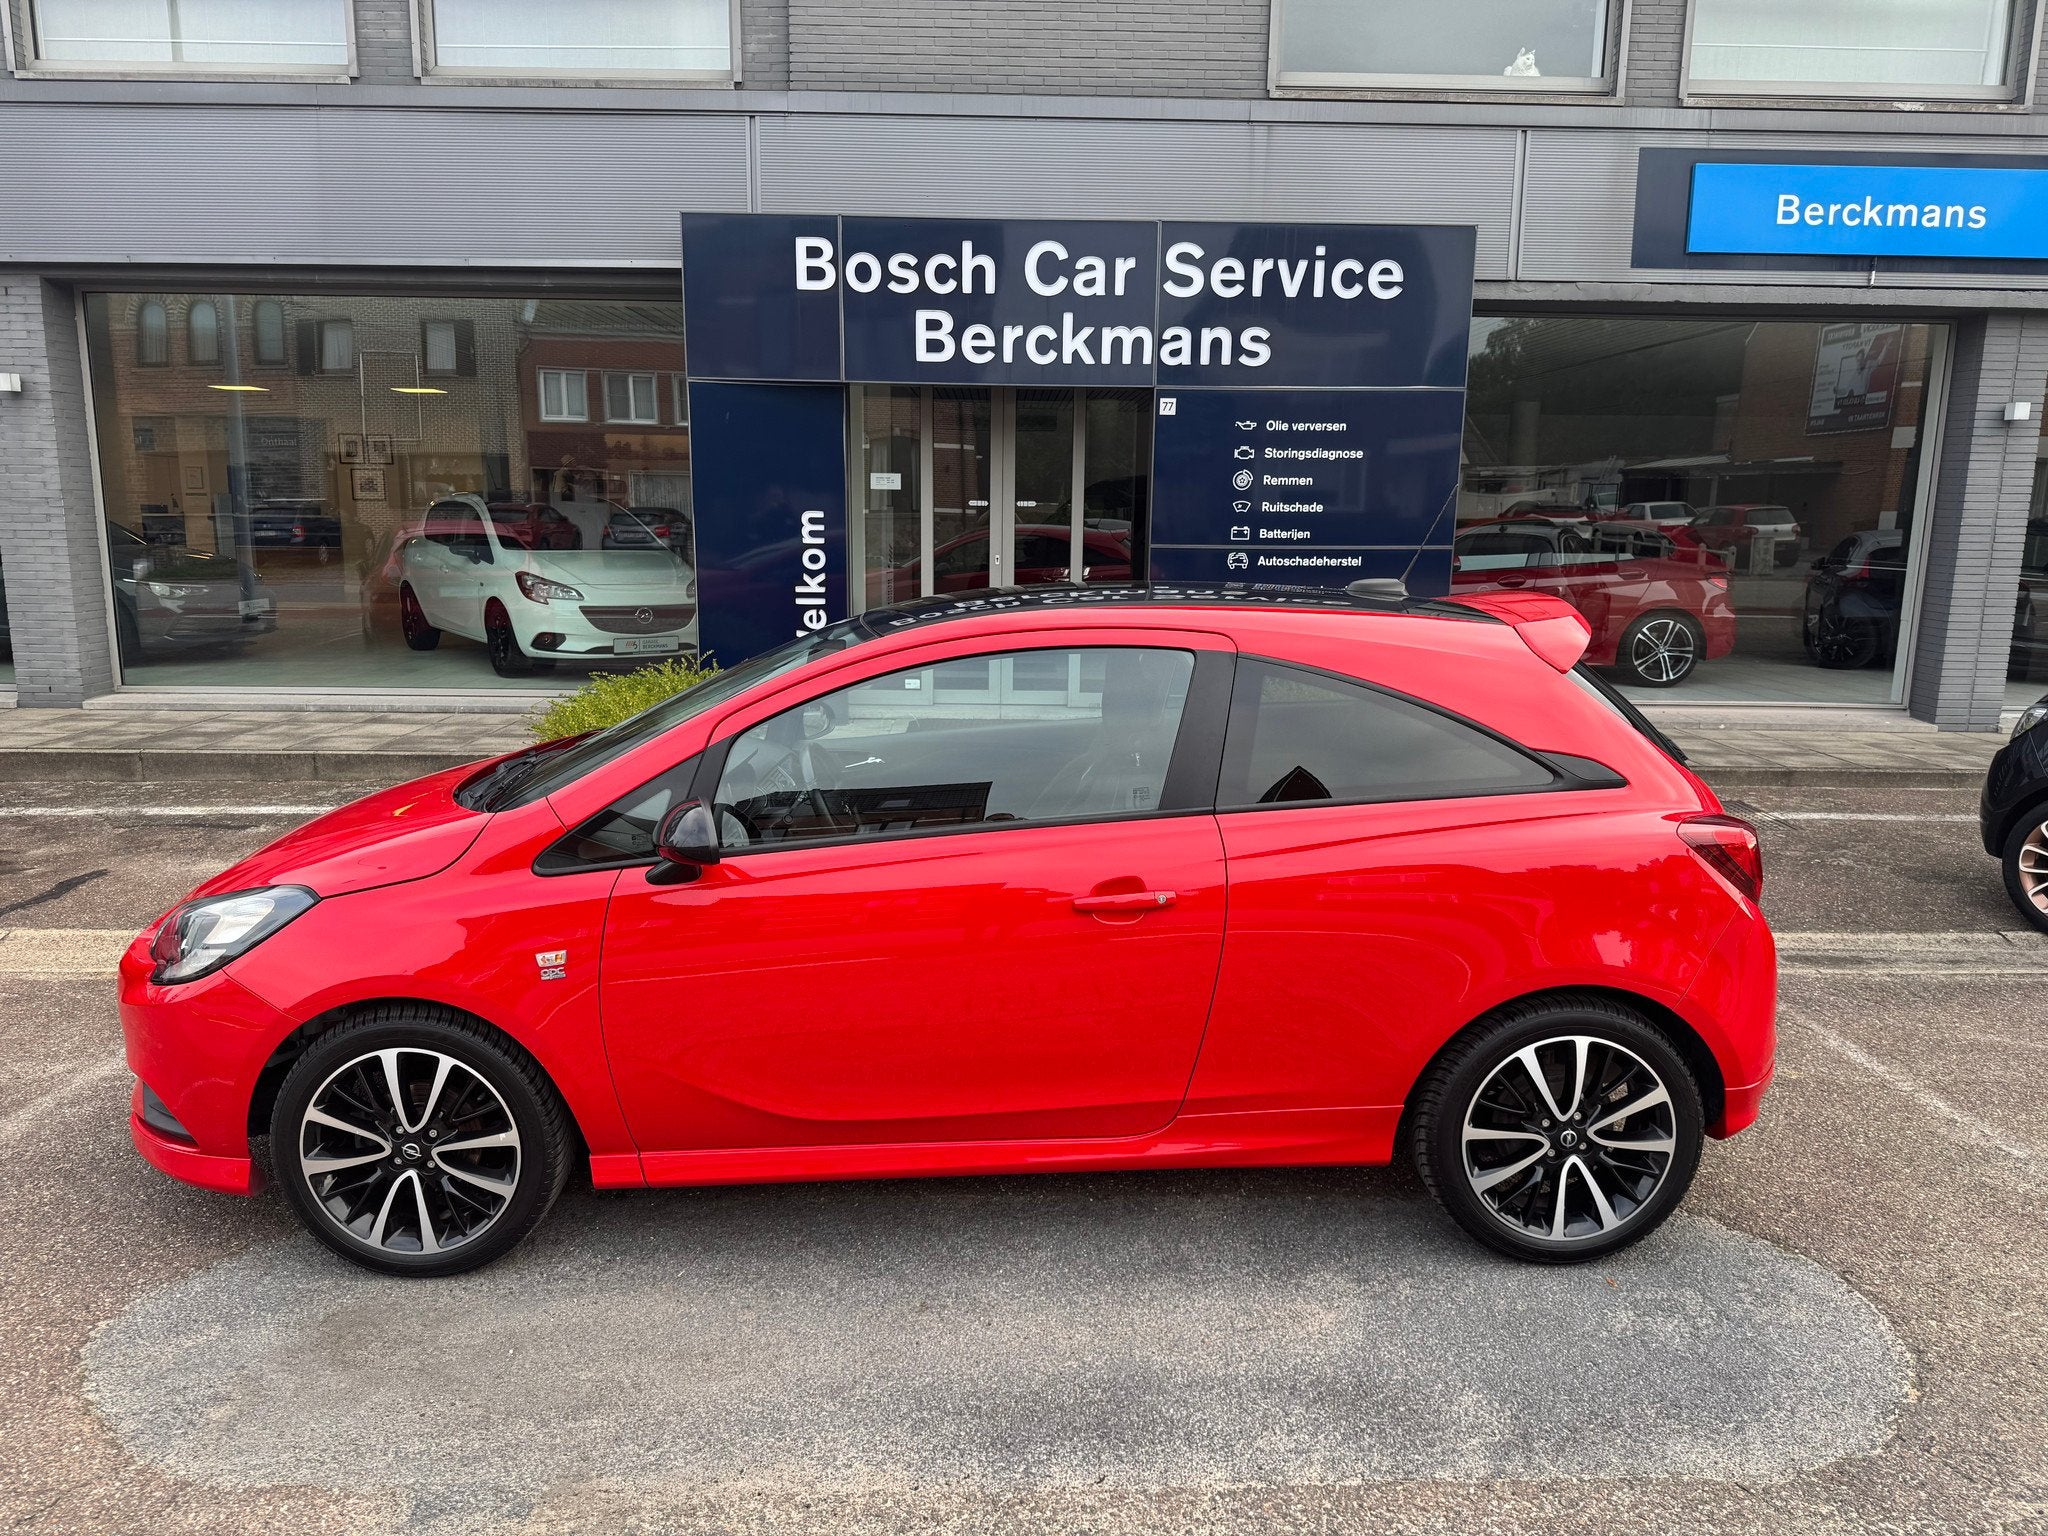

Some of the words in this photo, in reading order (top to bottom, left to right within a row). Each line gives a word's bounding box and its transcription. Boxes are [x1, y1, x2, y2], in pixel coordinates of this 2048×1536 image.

[1775, 193, 1988, 229] Berckmans
[794, 235, 997, 296] Bosch
[1023, 239, 1137, 298] Car
[1161, 240, 1405, 301] Service
[914, 308, 1272, 368] Berckmans
[1162, 401, 1174, 412] 77
[1265, 419, 1289, 432] Olie
[1291, 422, 1347, 432] verversen
[260, 438, 298, 447] Onthaal
[1264, 447, 1364, 461] Storingsdiagnose
[1263, 474, 1313, 486] Remmen
[1261, 501, 1324, 513] Ruitschade
[1259, 528, 1311, 541] Batterijen
[1257, 555, 1362, 567] Autoschadeherstel
[540, 966, 566, 977] OPC
